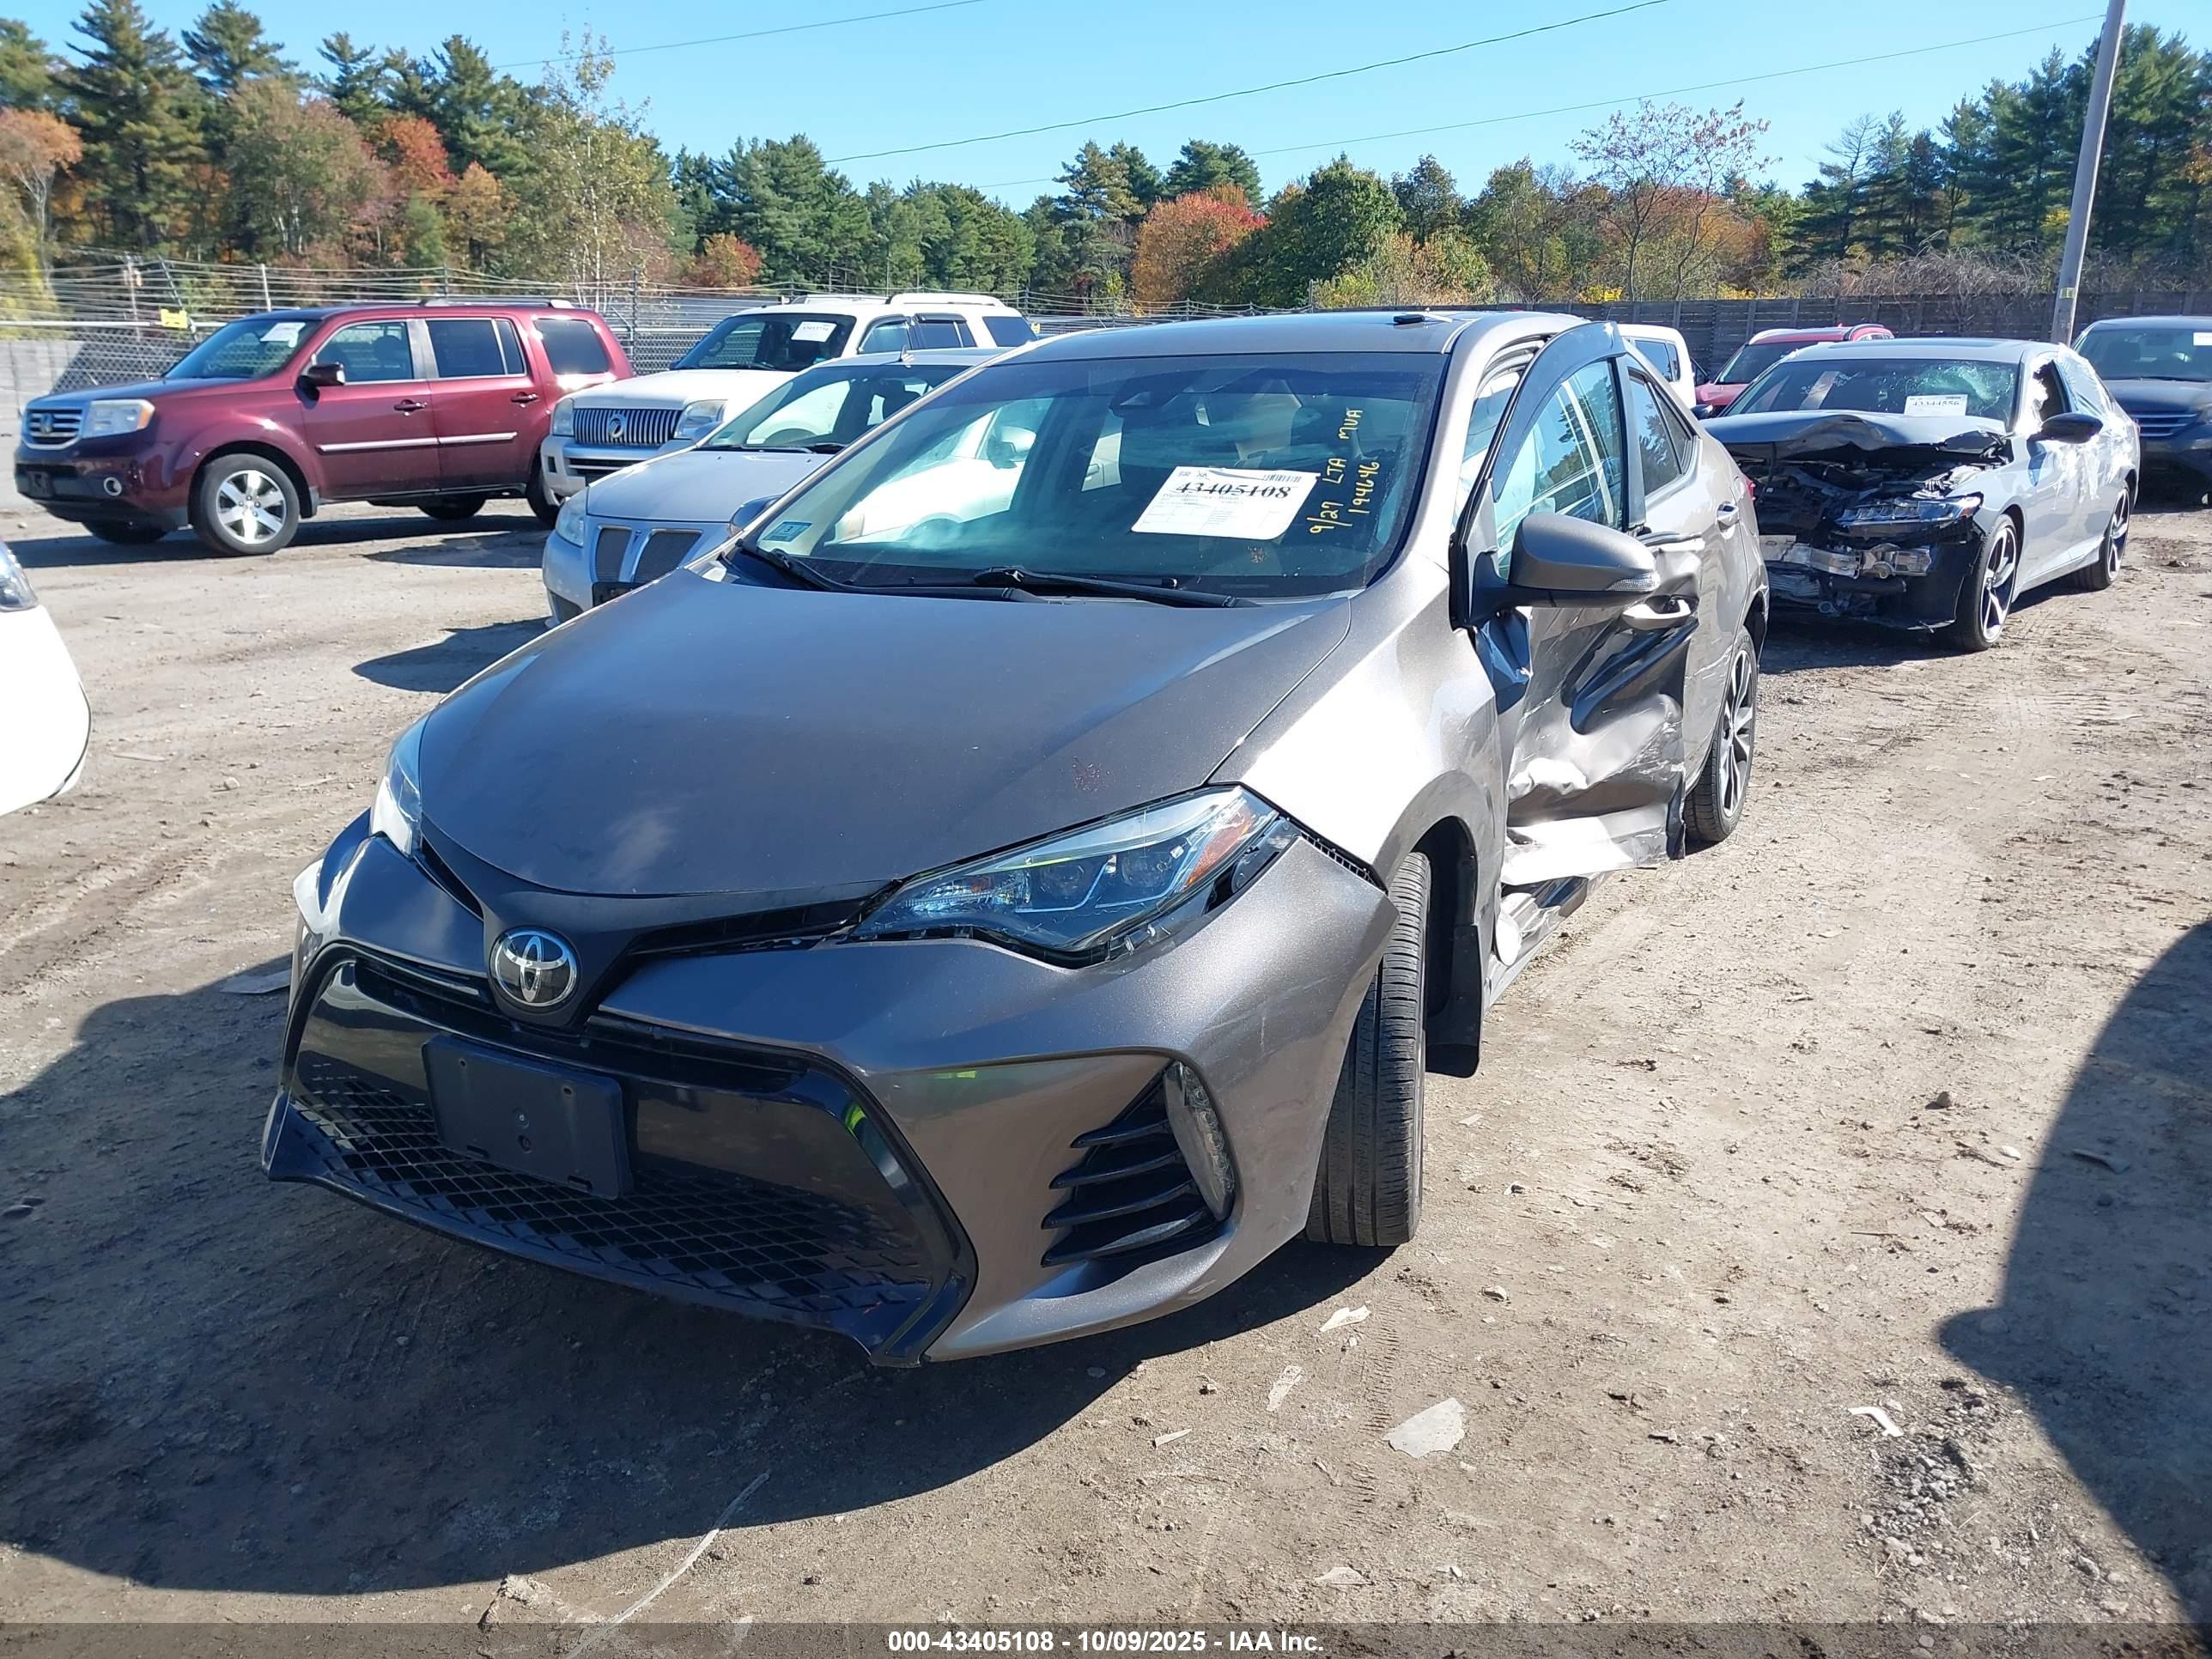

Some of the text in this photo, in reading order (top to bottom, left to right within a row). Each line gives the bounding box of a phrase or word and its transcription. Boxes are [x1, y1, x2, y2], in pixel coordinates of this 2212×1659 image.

[1322, 458, 1347, 484] LTA
[1176, 482, 1291, 499] 43405108
[1306, 501, 1353, 534] 9/27
